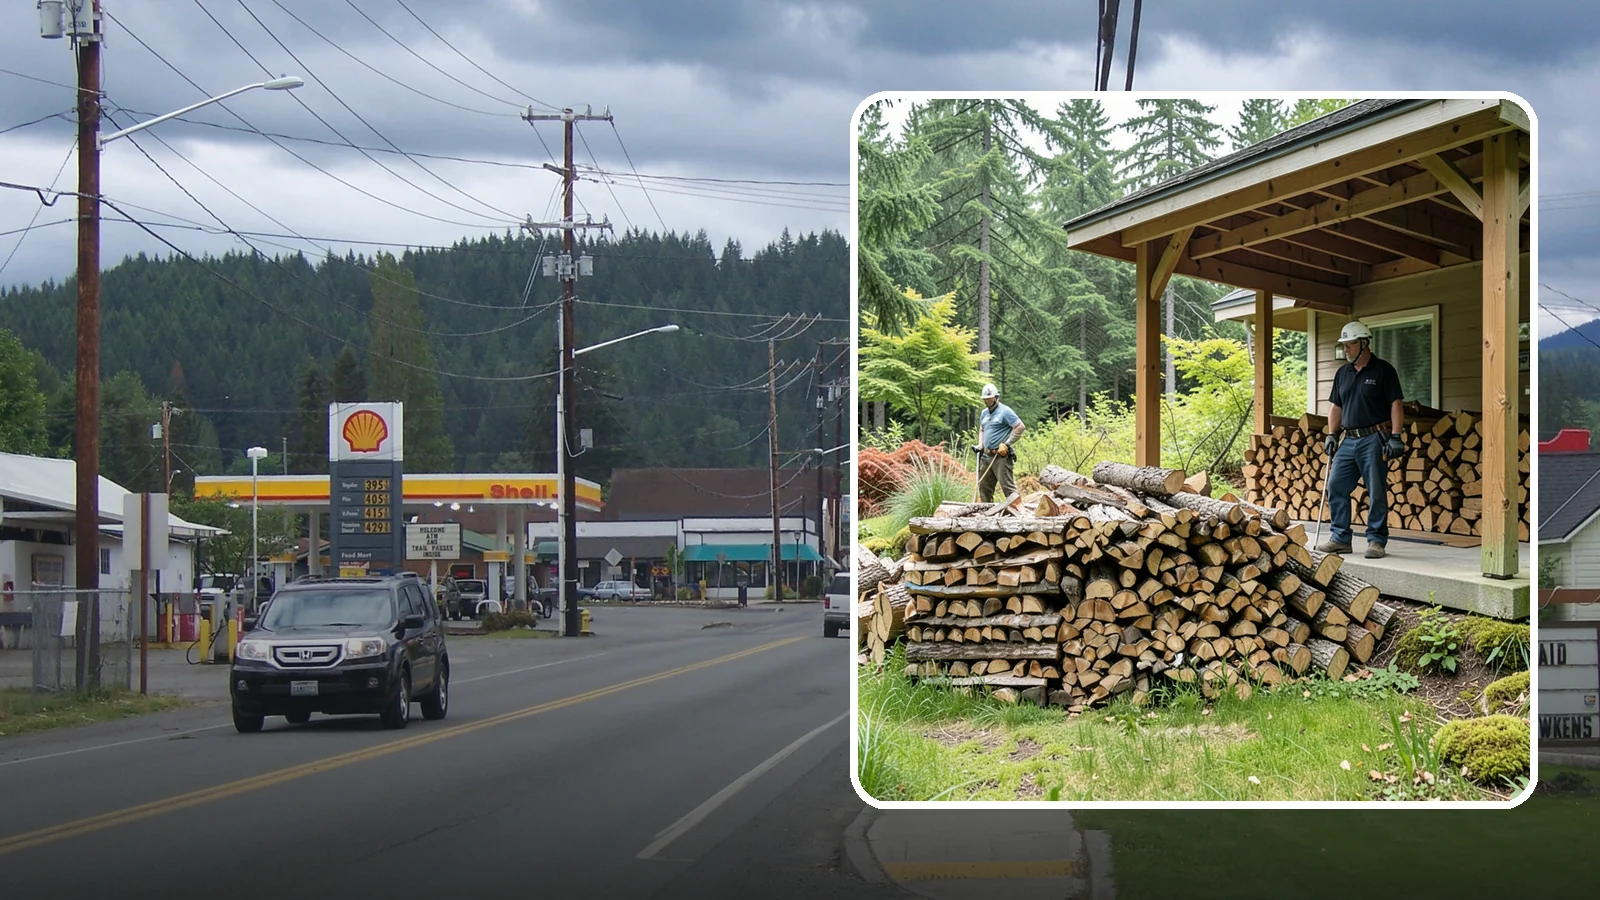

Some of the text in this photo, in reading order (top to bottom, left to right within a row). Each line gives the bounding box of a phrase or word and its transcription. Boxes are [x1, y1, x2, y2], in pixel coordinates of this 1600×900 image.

[365, 480, 384, 490] 395
[490, 484, 547, 499] Shell
[365, 494, 384, 504] 405
[365, 508, 384, 518] 415
[365, 522, 384, 532] 429
